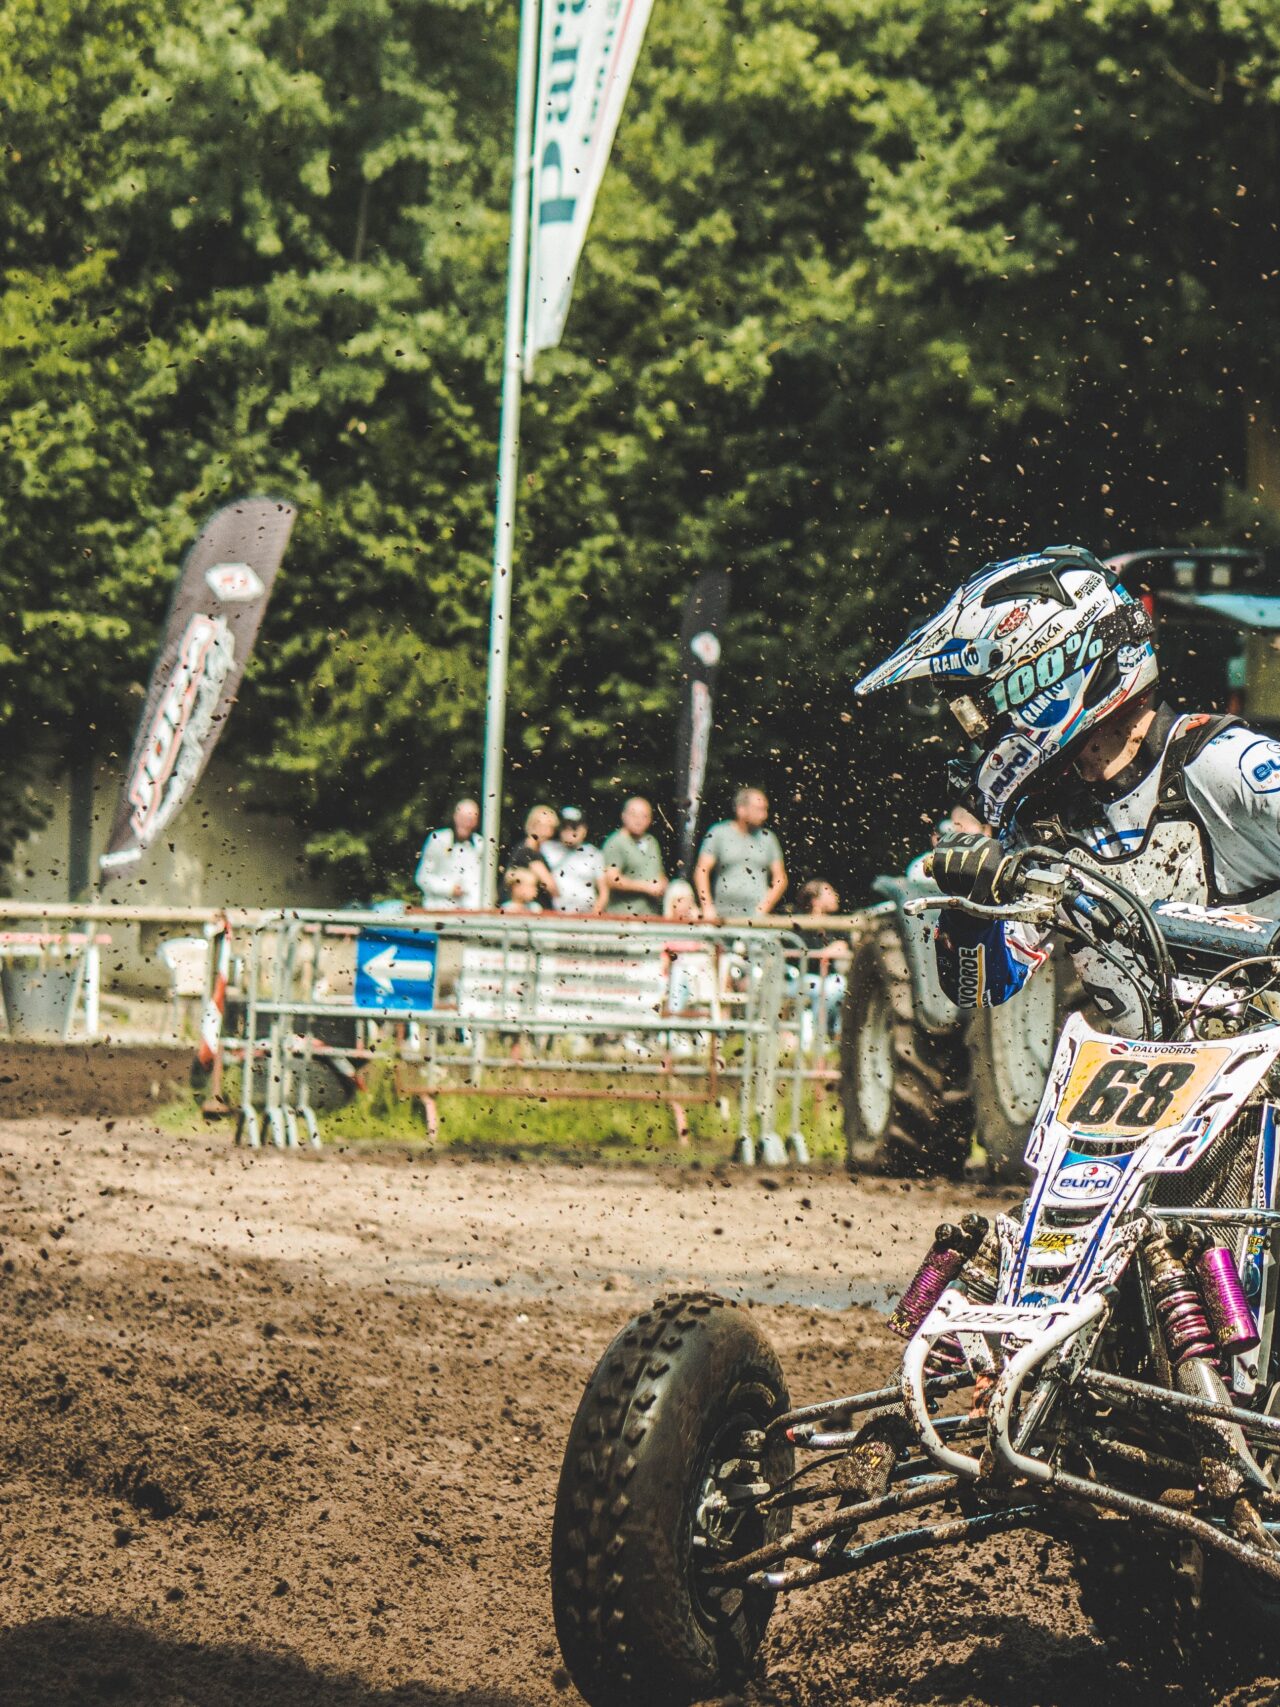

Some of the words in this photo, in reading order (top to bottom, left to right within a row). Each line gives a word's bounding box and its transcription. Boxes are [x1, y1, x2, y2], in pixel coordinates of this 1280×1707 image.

[987, 625, 1104, 715] 100%
[989, 742, 1034, 798] eurol
[1132, 1044, 1199, 1056] DALVOORDE
[1066, 1059, 1197, 1127] 68
[1059, 1176, 1114, 1190] eurol
